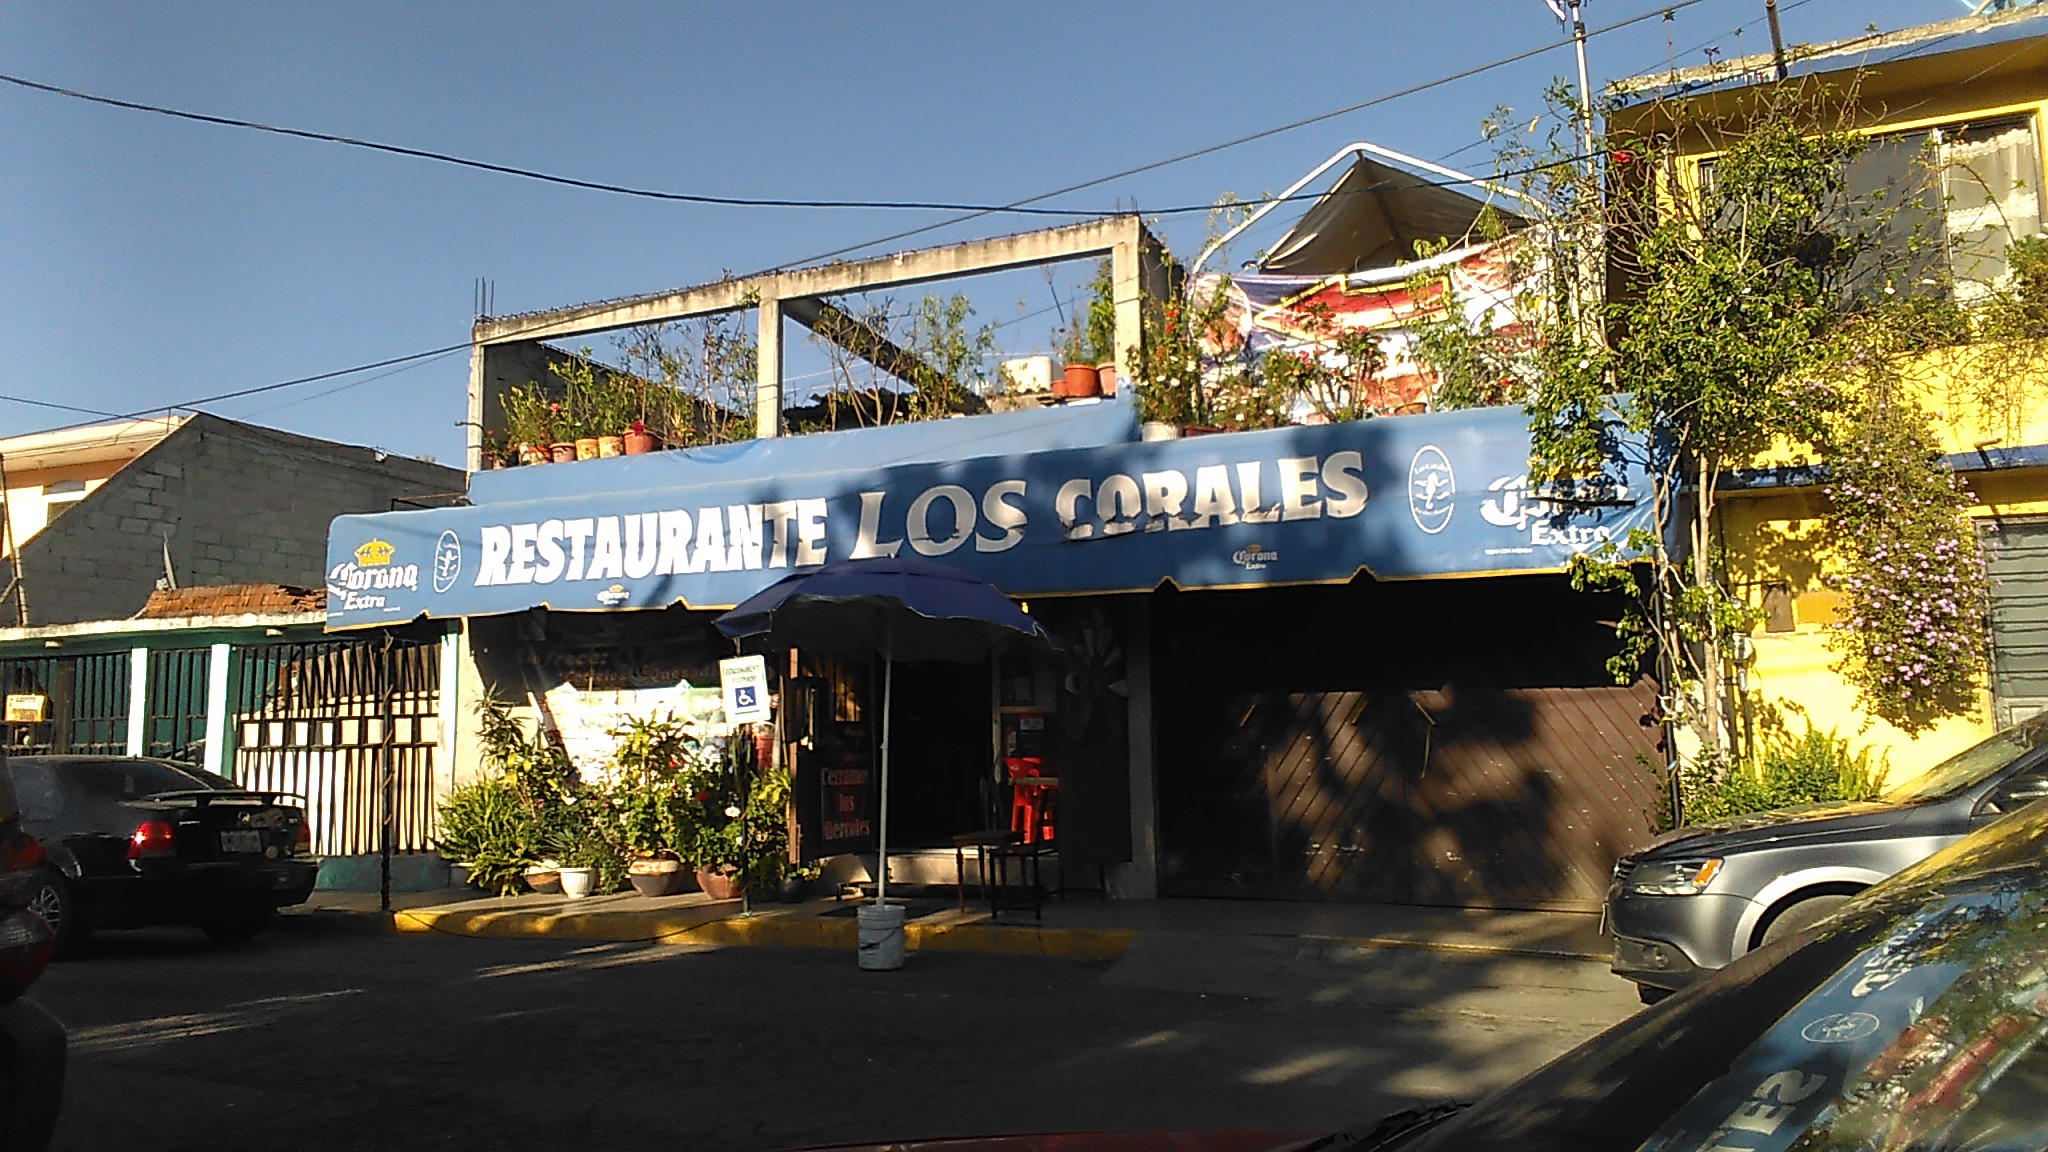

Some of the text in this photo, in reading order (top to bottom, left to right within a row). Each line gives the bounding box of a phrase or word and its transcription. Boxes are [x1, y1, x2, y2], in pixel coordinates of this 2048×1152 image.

[474, 450, 1369, 587] RESTAURANTE LOS CORALES
[1530, 518, 1610, 546] Extra
[1232, 550, 1278, 565] Corona
[327, 561, 418, 600] Corona
[343, 591, 386, 611] Extra
